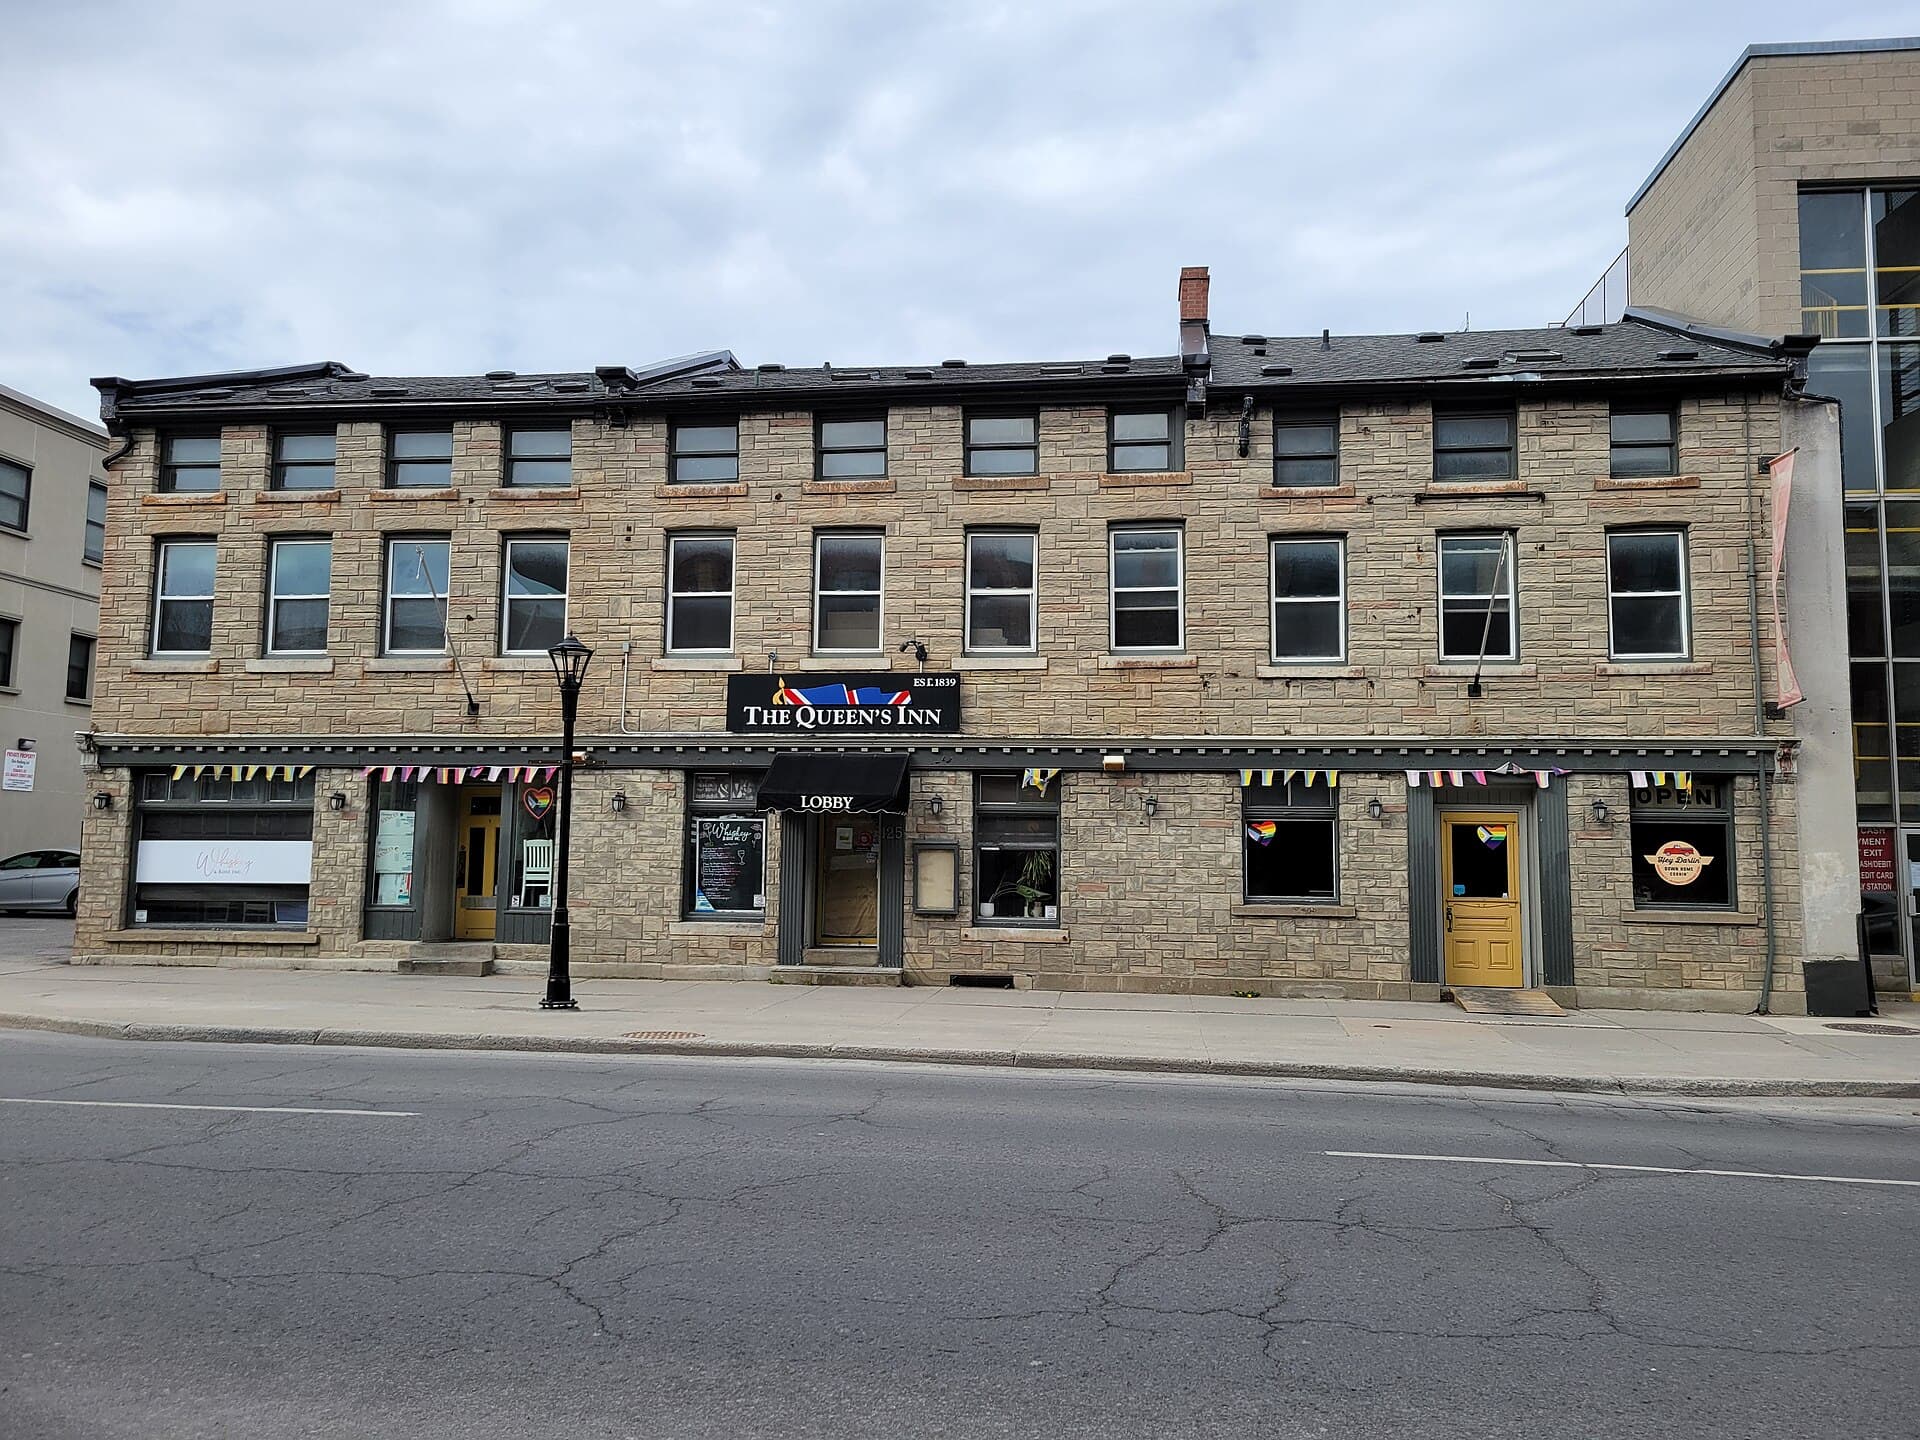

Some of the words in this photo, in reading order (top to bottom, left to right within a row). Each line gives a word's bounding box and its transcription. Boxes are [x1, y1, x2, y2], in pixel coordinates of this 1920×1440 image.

[743, 705, 791, 727] THE
[796, 705, 892, 729] QUEEN'S
[897, 705, 942, 725] INN
[1636, 788, 1712, 805] OPEN
[800, 795, 854, 809] LOBBY
[1860, 827, 1886, 835] CASH
[1863, 849, 1884, 857] EXIT
[1876, 871, 1894, 880] CARD
[1866, 882, 1892, 891] STATION
